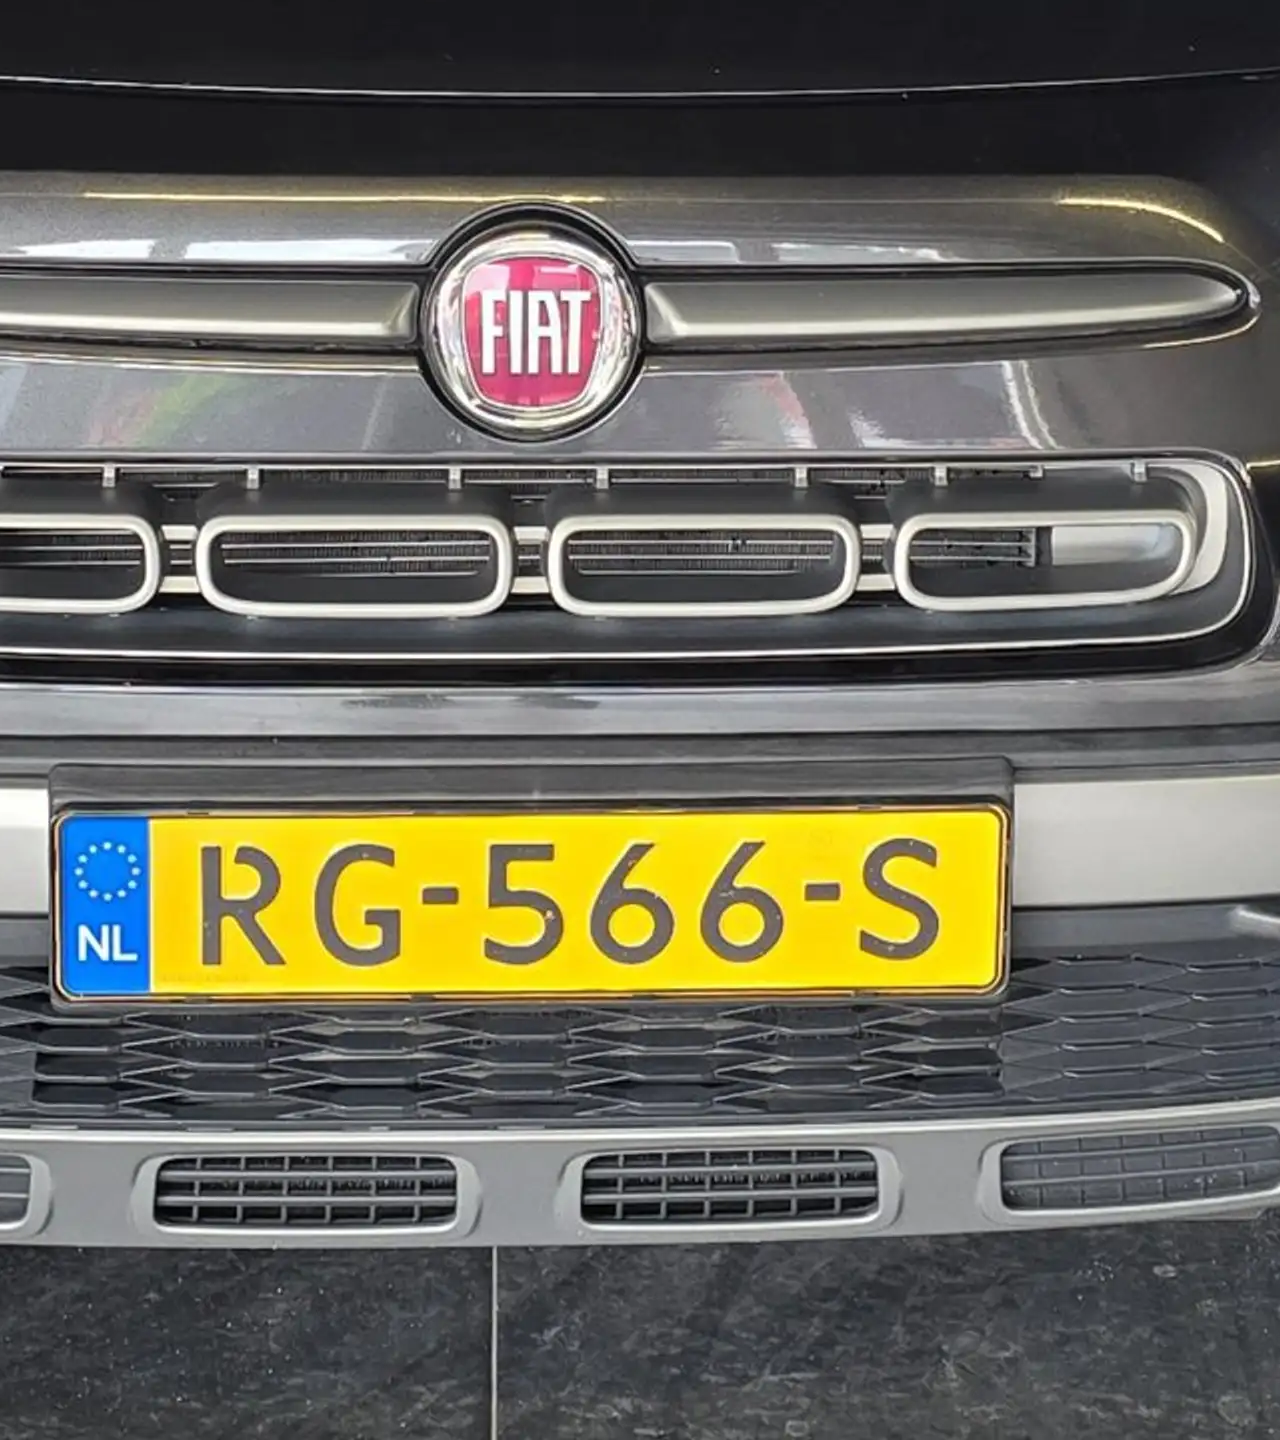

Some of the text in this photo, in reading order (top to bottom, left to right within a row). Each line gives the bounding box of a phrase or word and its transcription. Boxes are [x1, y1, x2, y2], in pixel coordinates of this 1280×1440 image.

[480, 290, 591, 374] FIAT
[78, 925, 138, 963] NL
[199, 838, 940, 966] RG-566-S
